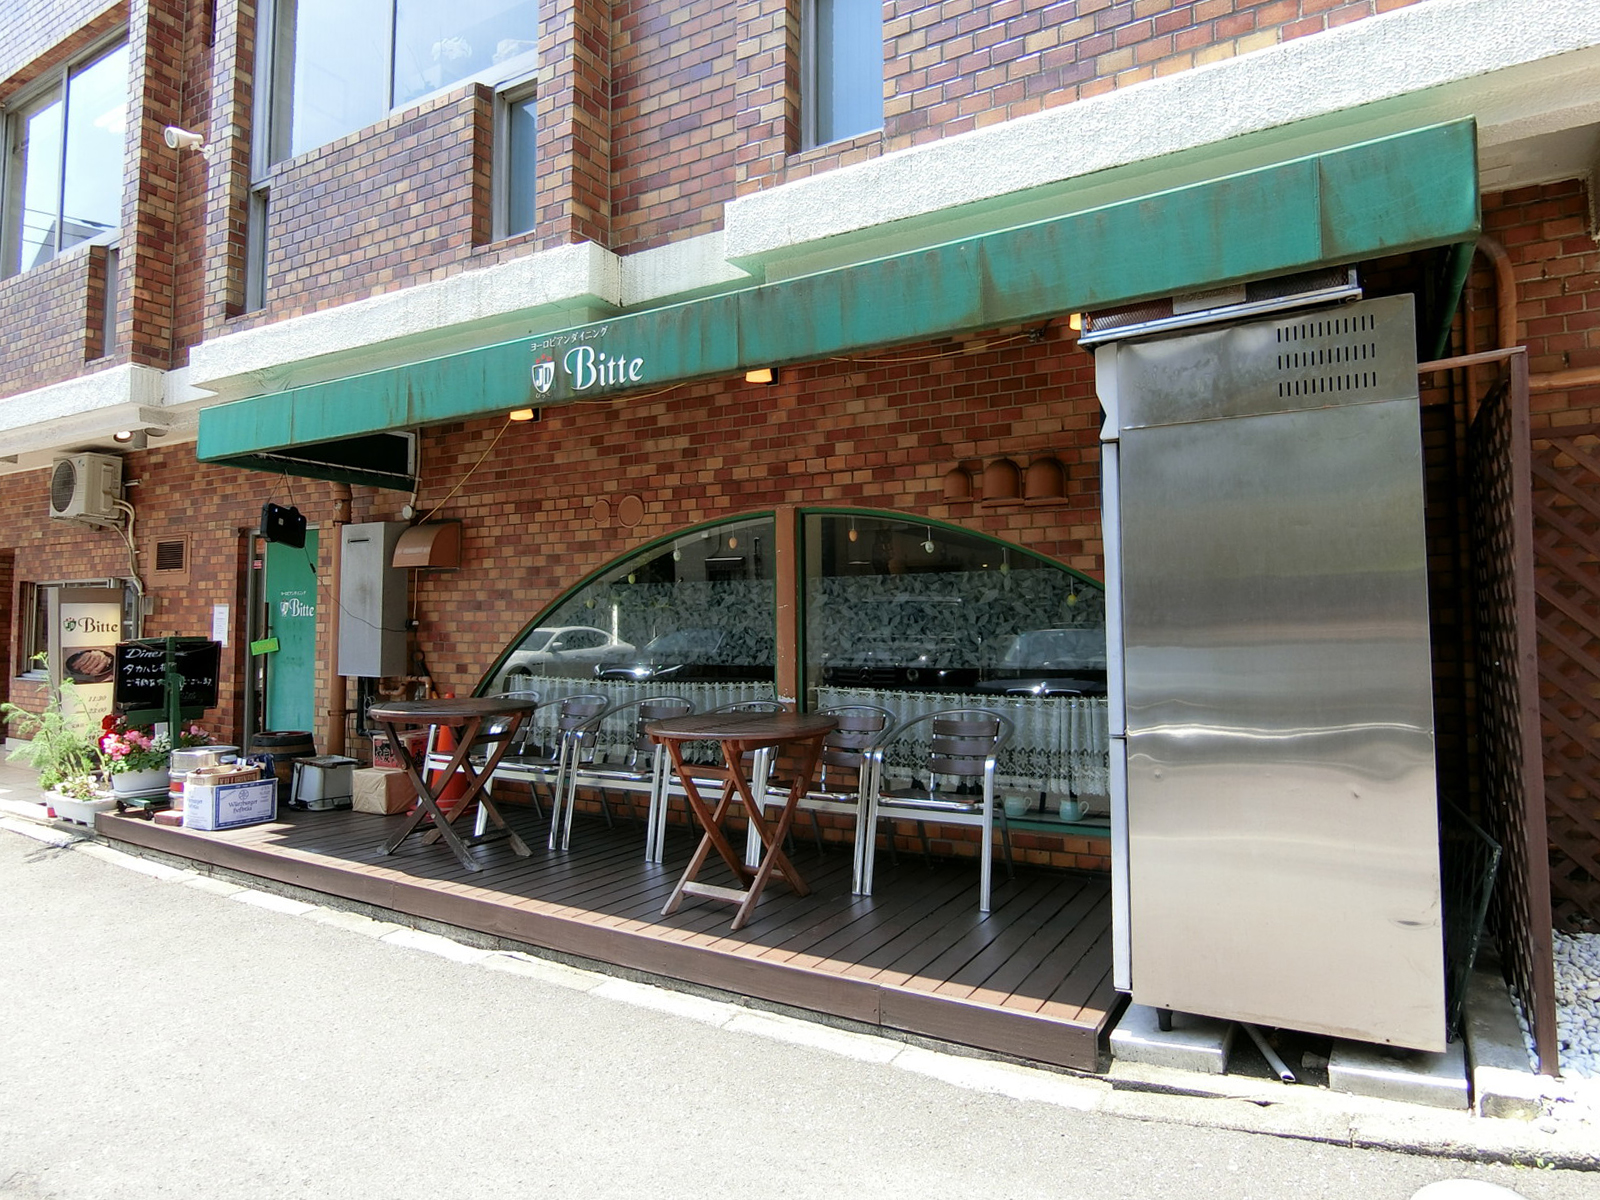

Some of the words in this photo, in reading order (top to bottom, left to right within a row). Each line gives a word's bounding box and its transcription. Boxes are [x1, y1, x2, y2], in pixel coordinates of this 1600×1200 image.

[530, 325, 609, 352] ヨーロピアンダイニング
[564, 345, 644, 390] Bitte
[289, 597, 315, 617] Bitte
[78, 616, 119, 633] Bitte
